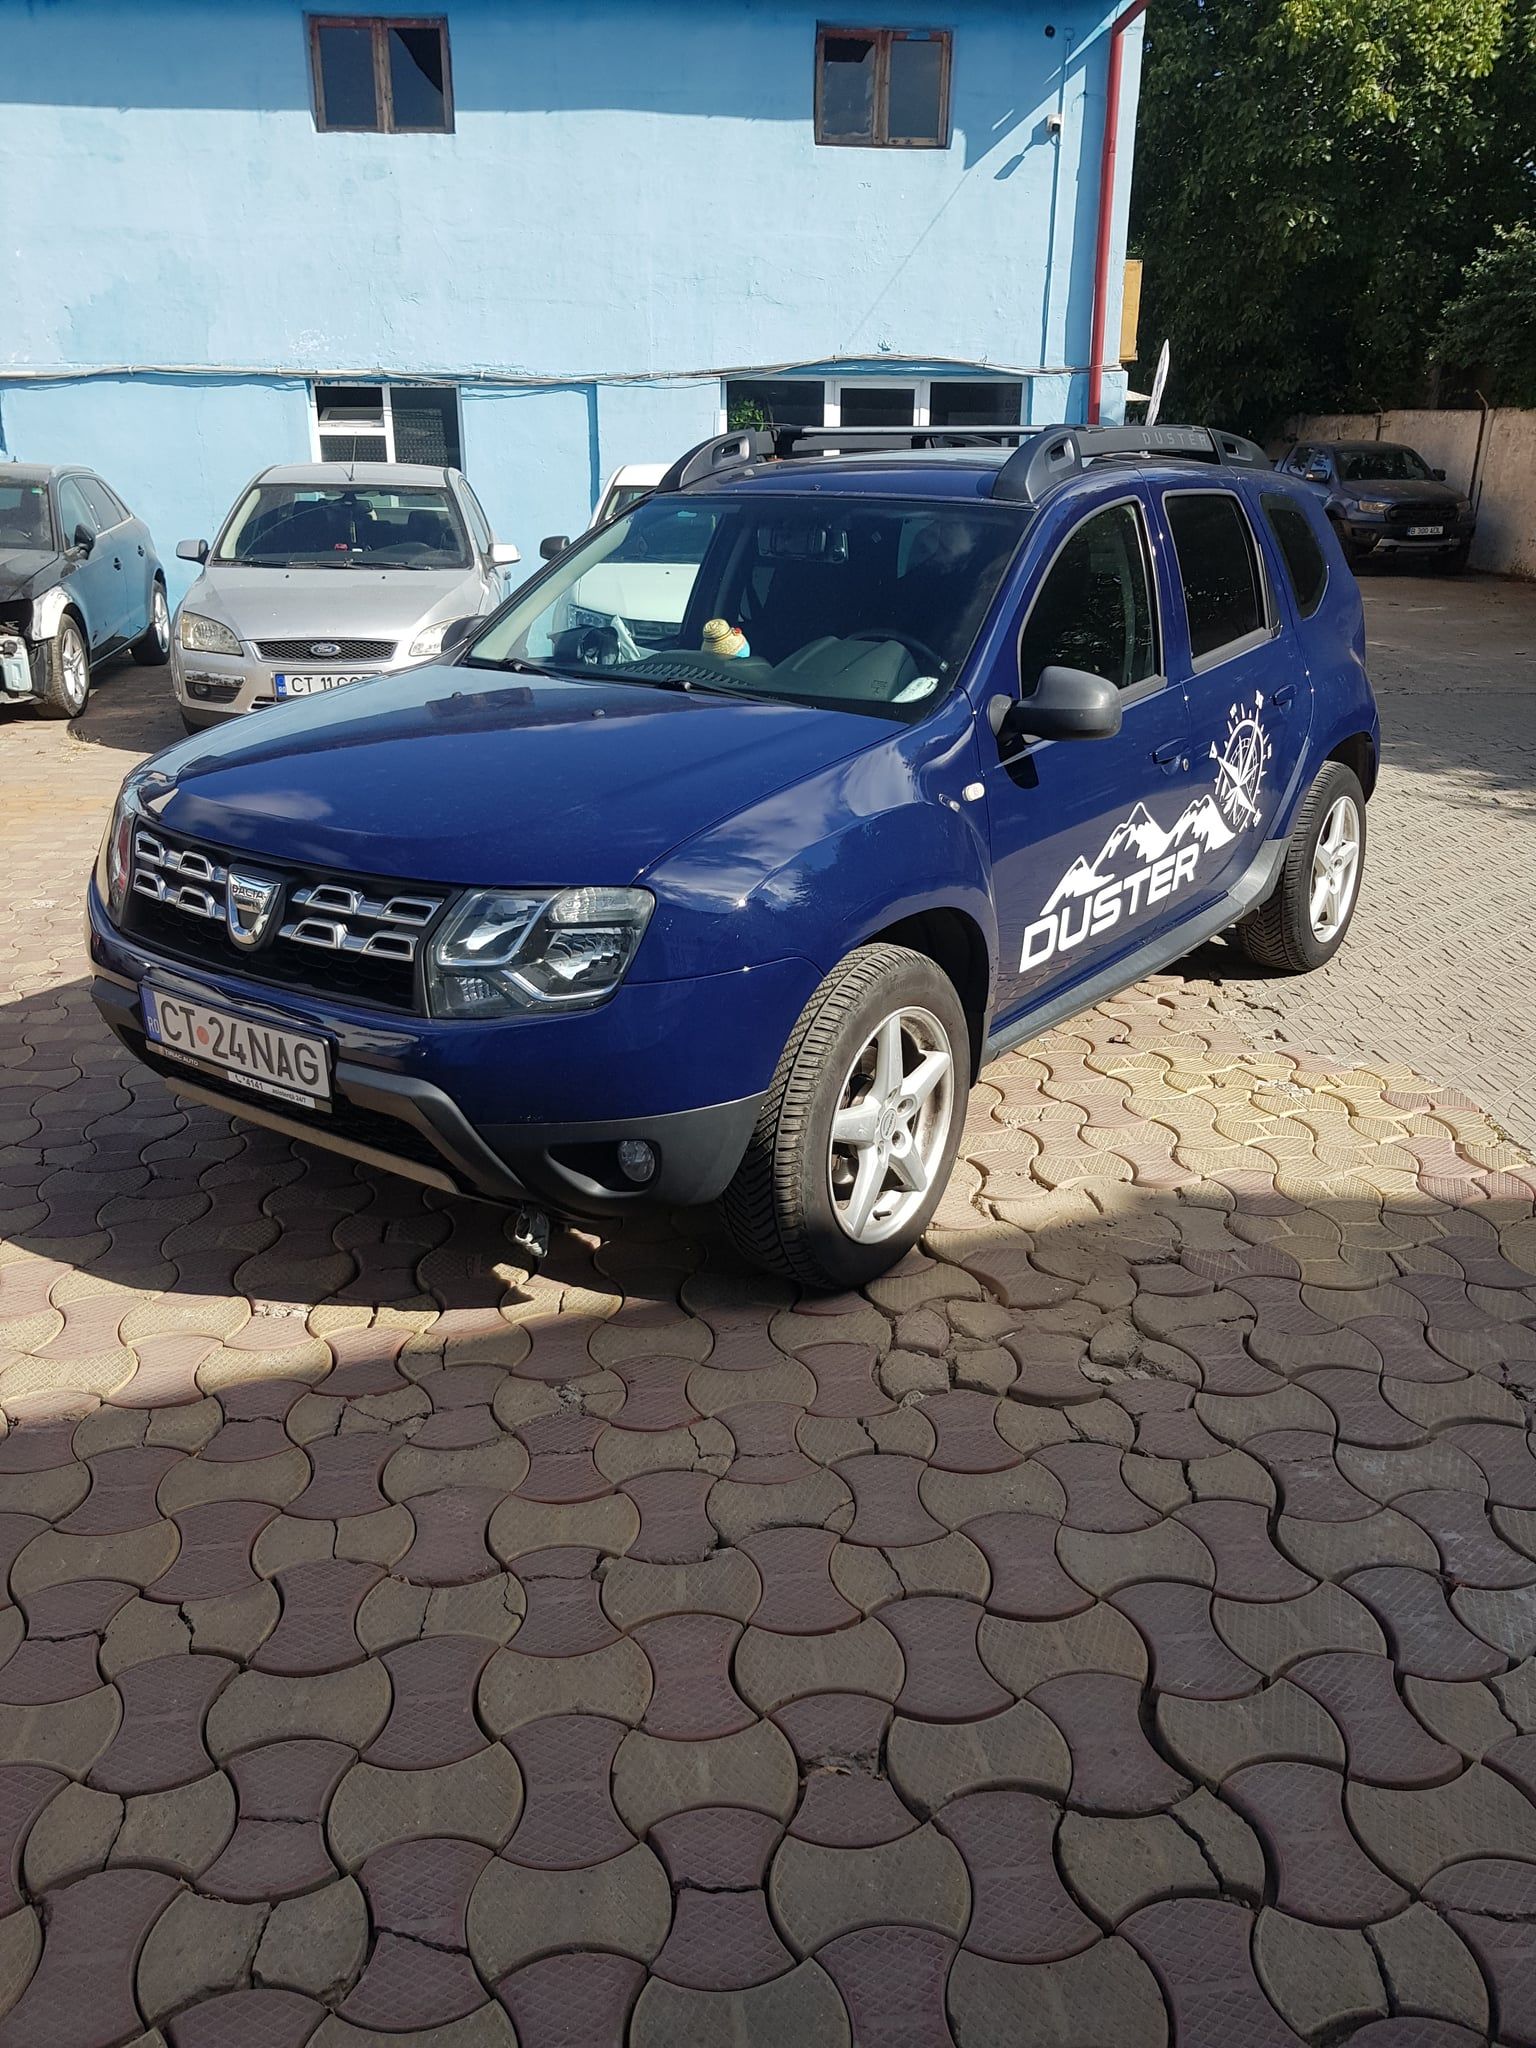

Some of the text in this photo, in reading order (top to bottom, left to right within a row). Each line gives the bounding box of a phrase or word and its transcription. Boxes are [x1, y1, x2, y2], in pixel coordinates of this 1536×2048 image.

[1142, 432, 1208, 447] DUSTER
[291, 677, 313, 692] CT
[232, 884, 265, 899] DACIA
[1019, 842, 1200, 973] DUSTER
[147, 1015, 160, 1034] RO
